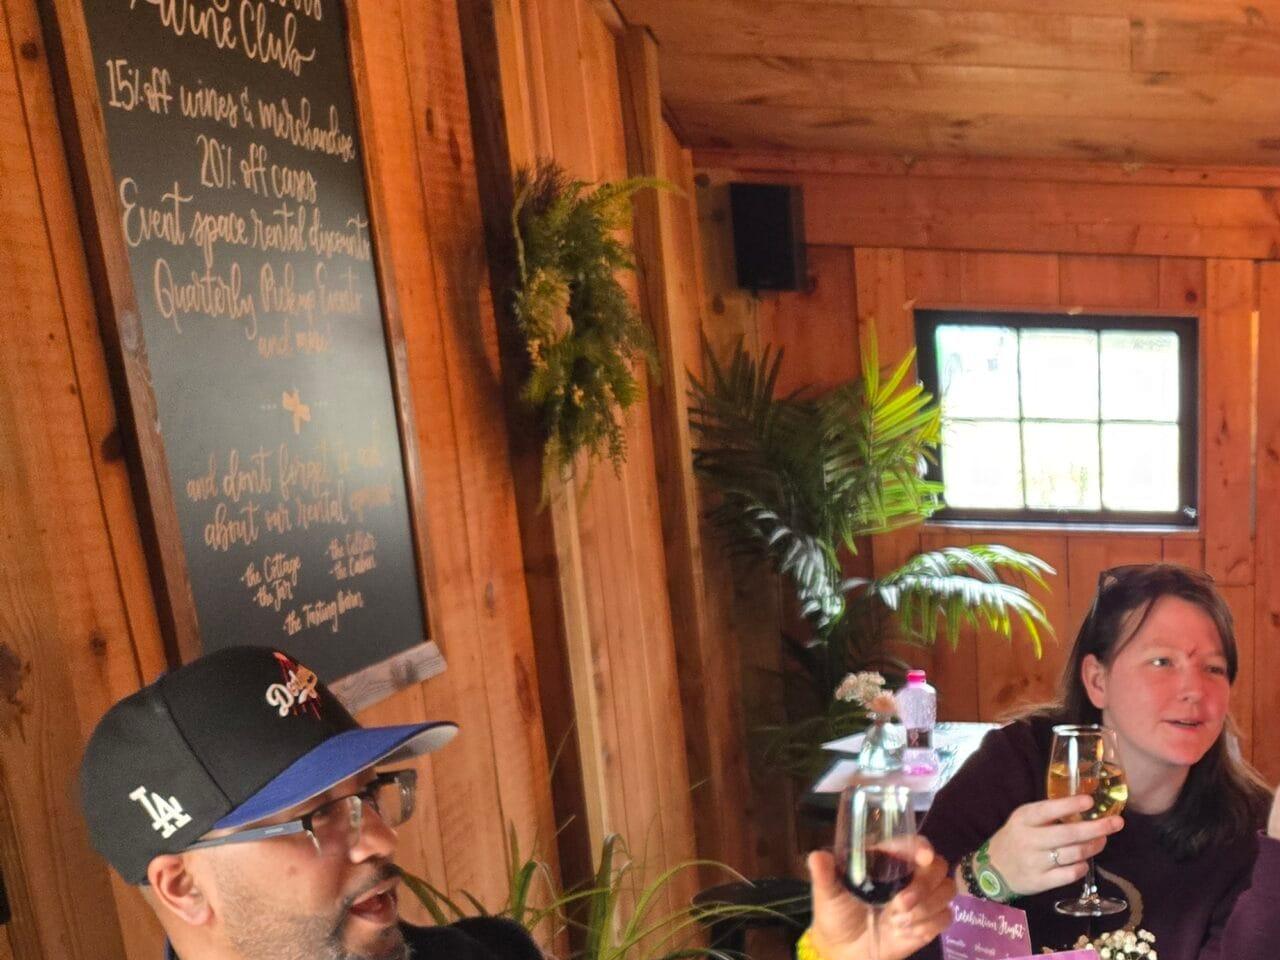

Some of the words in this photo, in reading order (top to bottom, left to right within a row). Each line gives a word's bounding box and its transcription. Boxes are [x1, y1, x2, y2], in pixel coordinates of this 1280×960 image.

[146, 0, 236, 49] Wine
[240, 0, 316, 77] Club
[143, 66, 173, 114] off
[180, 79, 237, 128] wines
[258, 97, 356, 162] merchandise
[240, 143, 268, 198] off
[271, 163, 317, 203] cases
[119, 177, 193, 247] Event
[190, 208, 248, 267] space
[251, 202, 306, 252] rental
[308, 207, 370, 262] discounts
[154, 257, 257, 340] Quarterly
[258, 319, 292, 358] and
[186, 452, 218, 501] and
[204, 502, 260, 552] about
[264, 504, 293, 534] our
[294, 480, 349, 530] rental
[244, 561, 262, 588] the
[264, 552, 301, 586] Cottage
[284, 609, 302, 635] the
[302, 600, 338, 632] Tasting
[129, 786, 193, 840] LA
[953, 904, 998, 931] Celebration
[998, 914, 1026, 939] Flight
